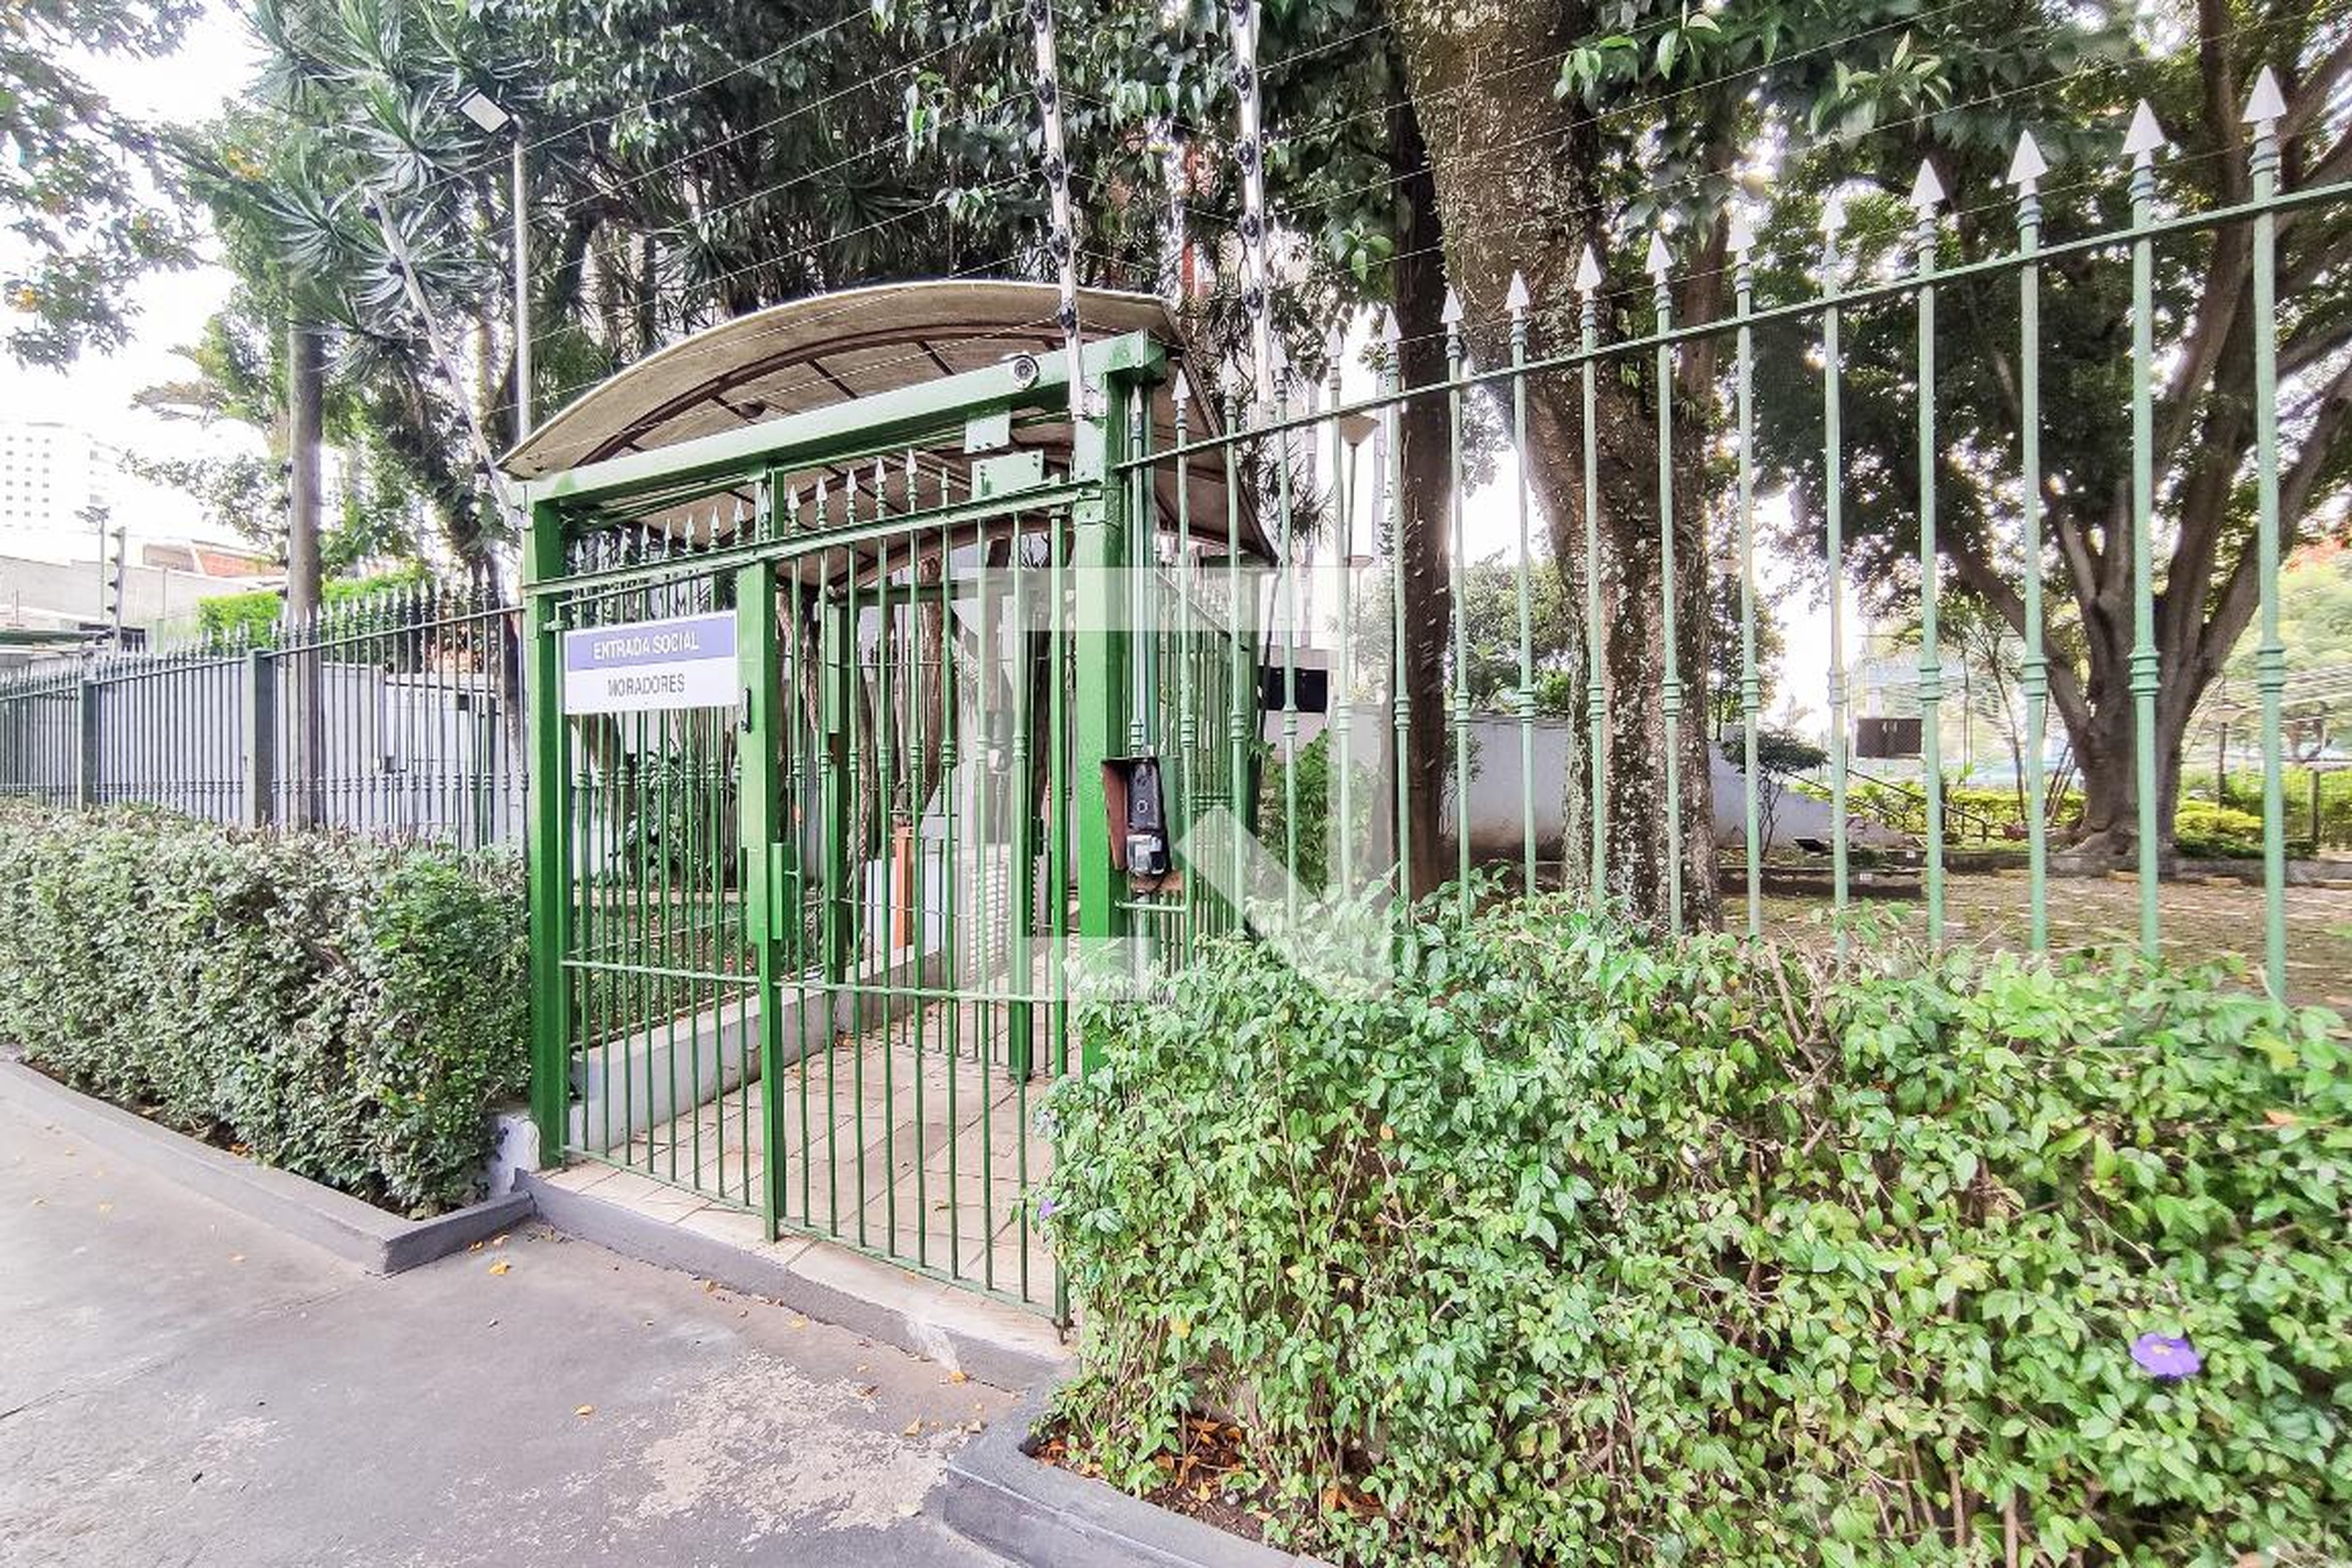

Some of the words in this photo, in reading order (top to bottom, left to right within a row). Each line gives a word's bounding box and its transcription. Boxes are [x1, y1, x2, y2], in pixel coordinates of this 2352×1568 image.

[594, 637, 650, 660] ENTRADA
[653, 631, 699, 654] SOCIAL
[608, 673, 685, 697] MORADORES
